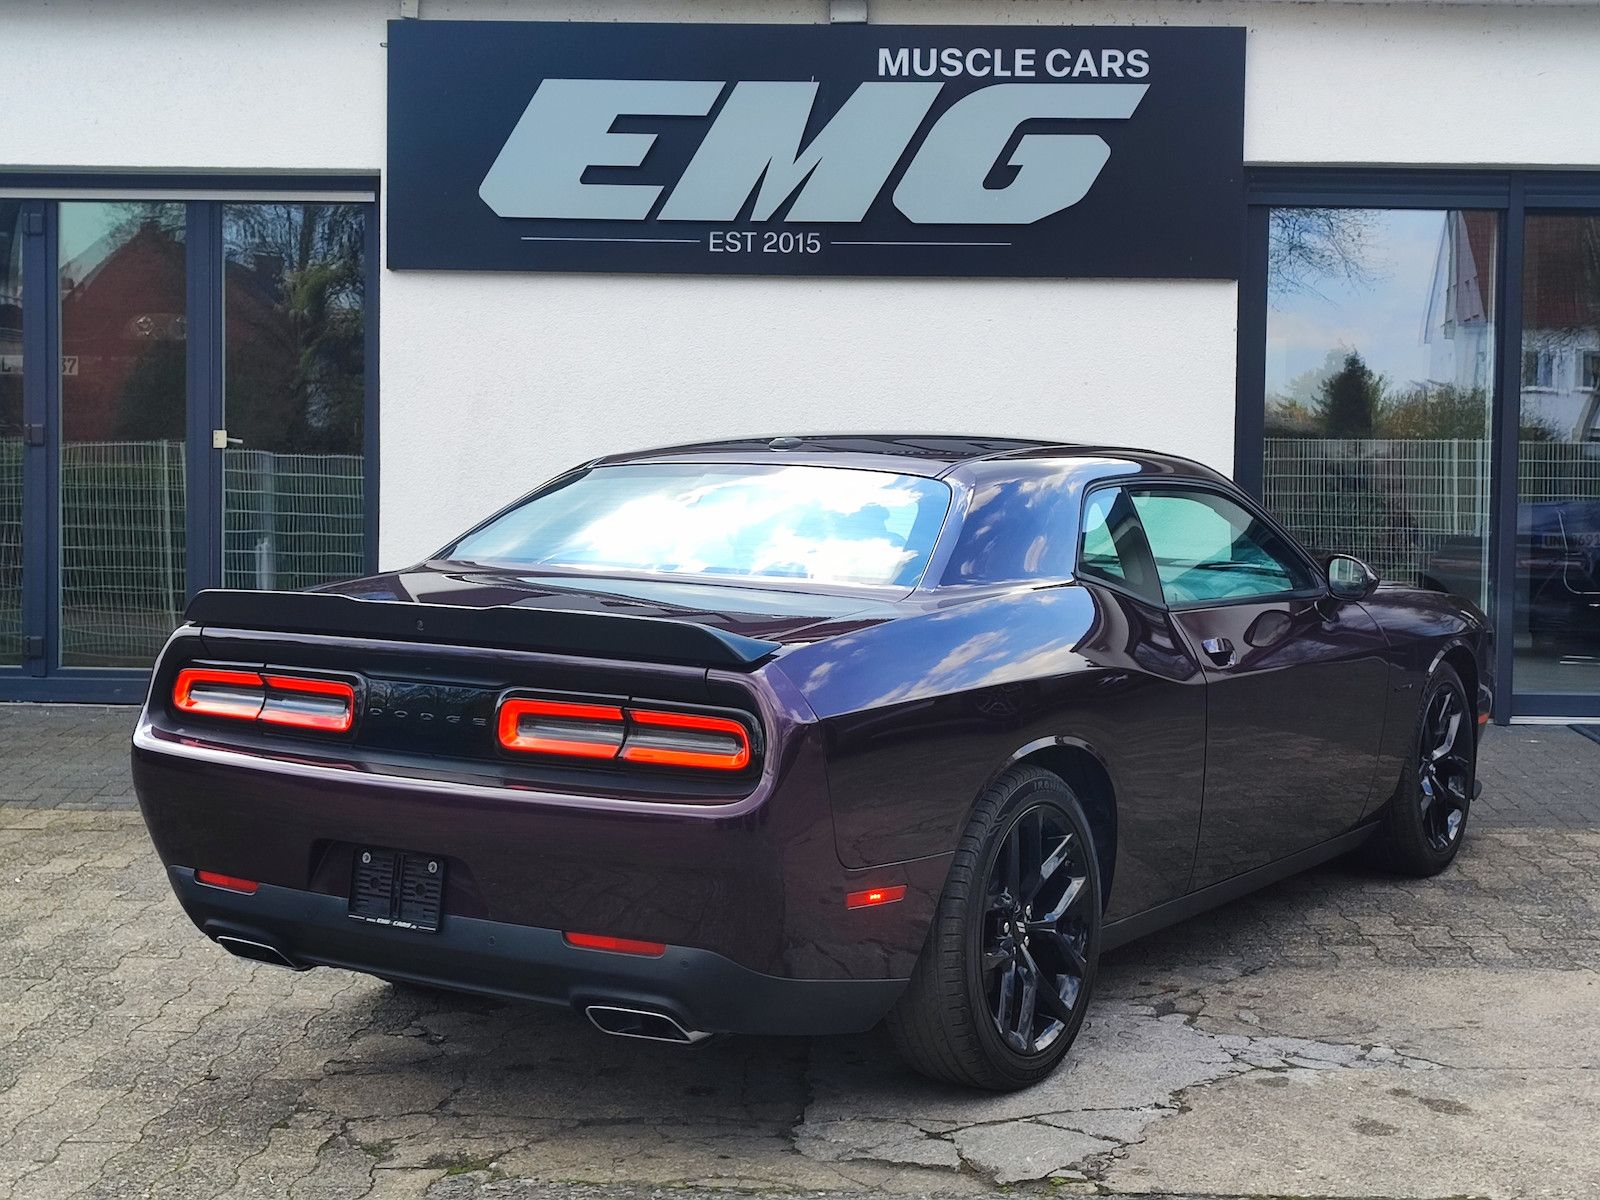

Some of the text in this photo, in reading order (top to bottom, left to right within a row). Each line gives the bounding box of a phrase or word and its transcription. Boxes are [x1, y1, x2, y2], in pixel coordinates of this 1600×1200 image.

[878, 47, 1150, 79] MUSCLE CARS
[478, 78, 1151, 225] EMG
[708, 231, 822, 254] EST 2015
[369, 707, 487, 727] DODGE
